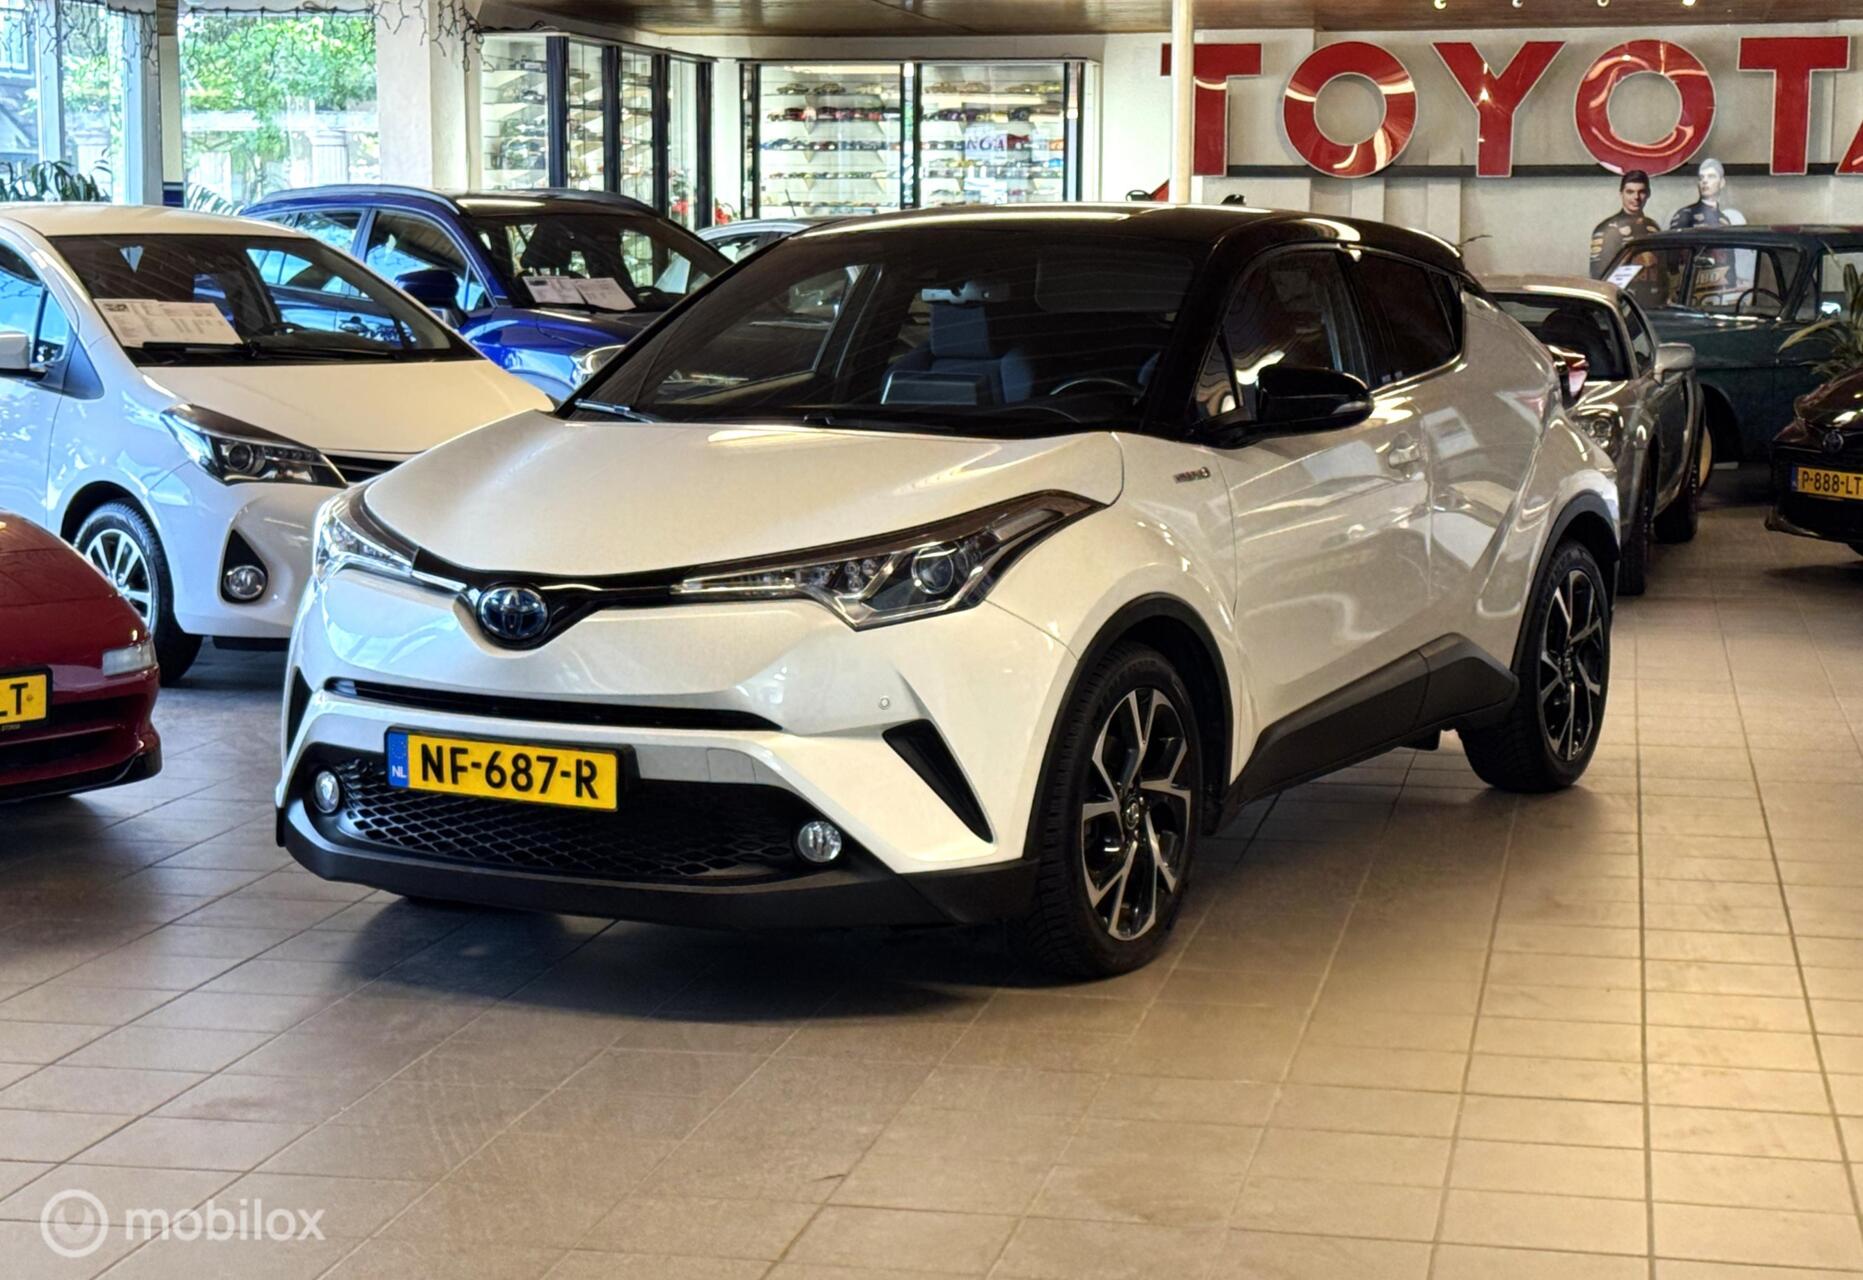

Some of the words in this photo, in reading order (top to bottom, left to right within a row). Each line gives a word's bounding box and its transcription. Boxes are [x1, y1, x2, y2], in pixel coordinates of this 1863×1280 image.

[1160, 35, 1863, 178] TOYOT
[1801, 470, 1862, 496] P-888-LT
[391, 764, 407, 778] NL
[420, 743, 599, 800] NF-687-R
